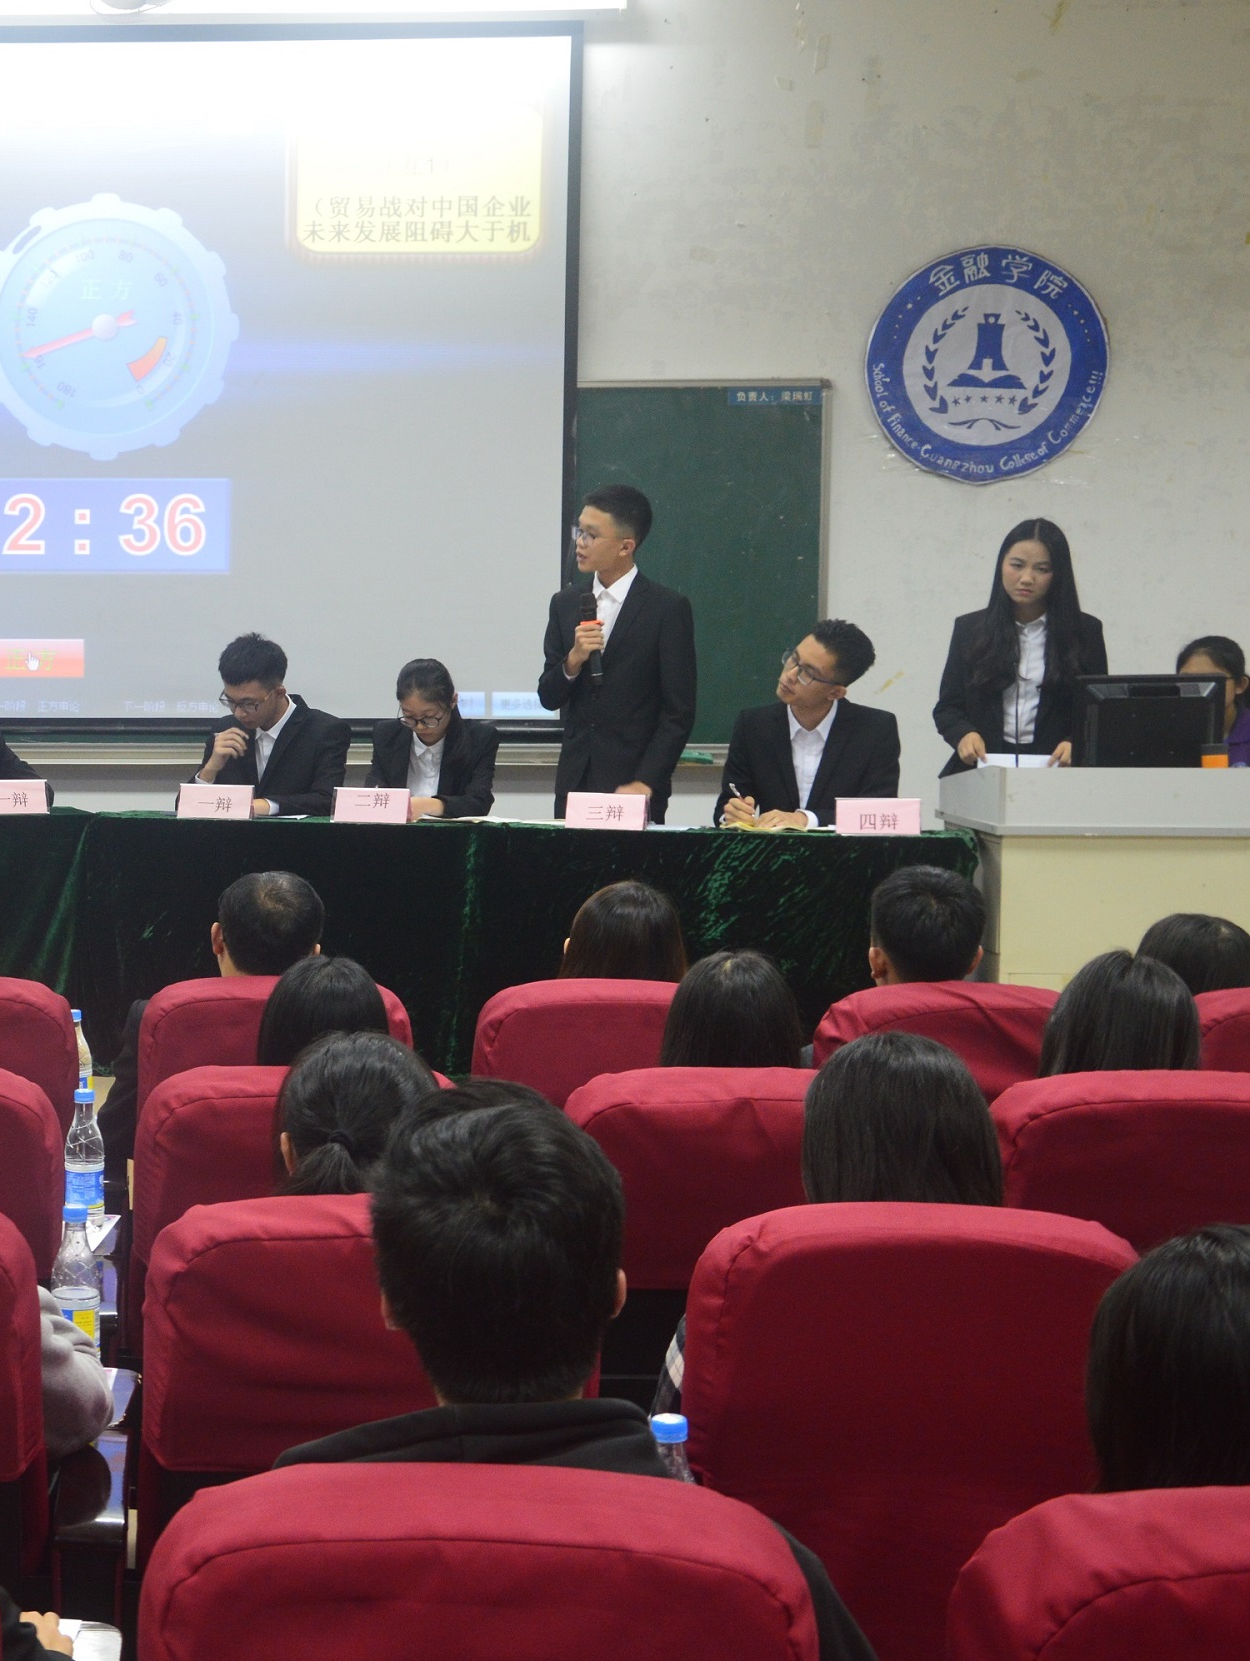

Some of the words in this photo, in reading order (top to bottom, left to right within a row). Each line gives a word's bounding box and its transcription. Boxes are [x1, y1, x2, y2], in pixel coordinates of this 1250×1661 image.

[301, 219, 532, 244] 未来发展阻碍大于机
[119, 249, 134, 263] 80
[927, 251, 1070, 300] 金融学院
[873, 362, 891, 399] School
[879, 400, 896, 413] of
[1037, 441, 1049, 456] of
[197, 796, 233, 813] 一辩
[354, 792, 391, 809] 二辩
[585, 804, 625, 823] 三辩
[858, 811, 899, 831] 四辩
